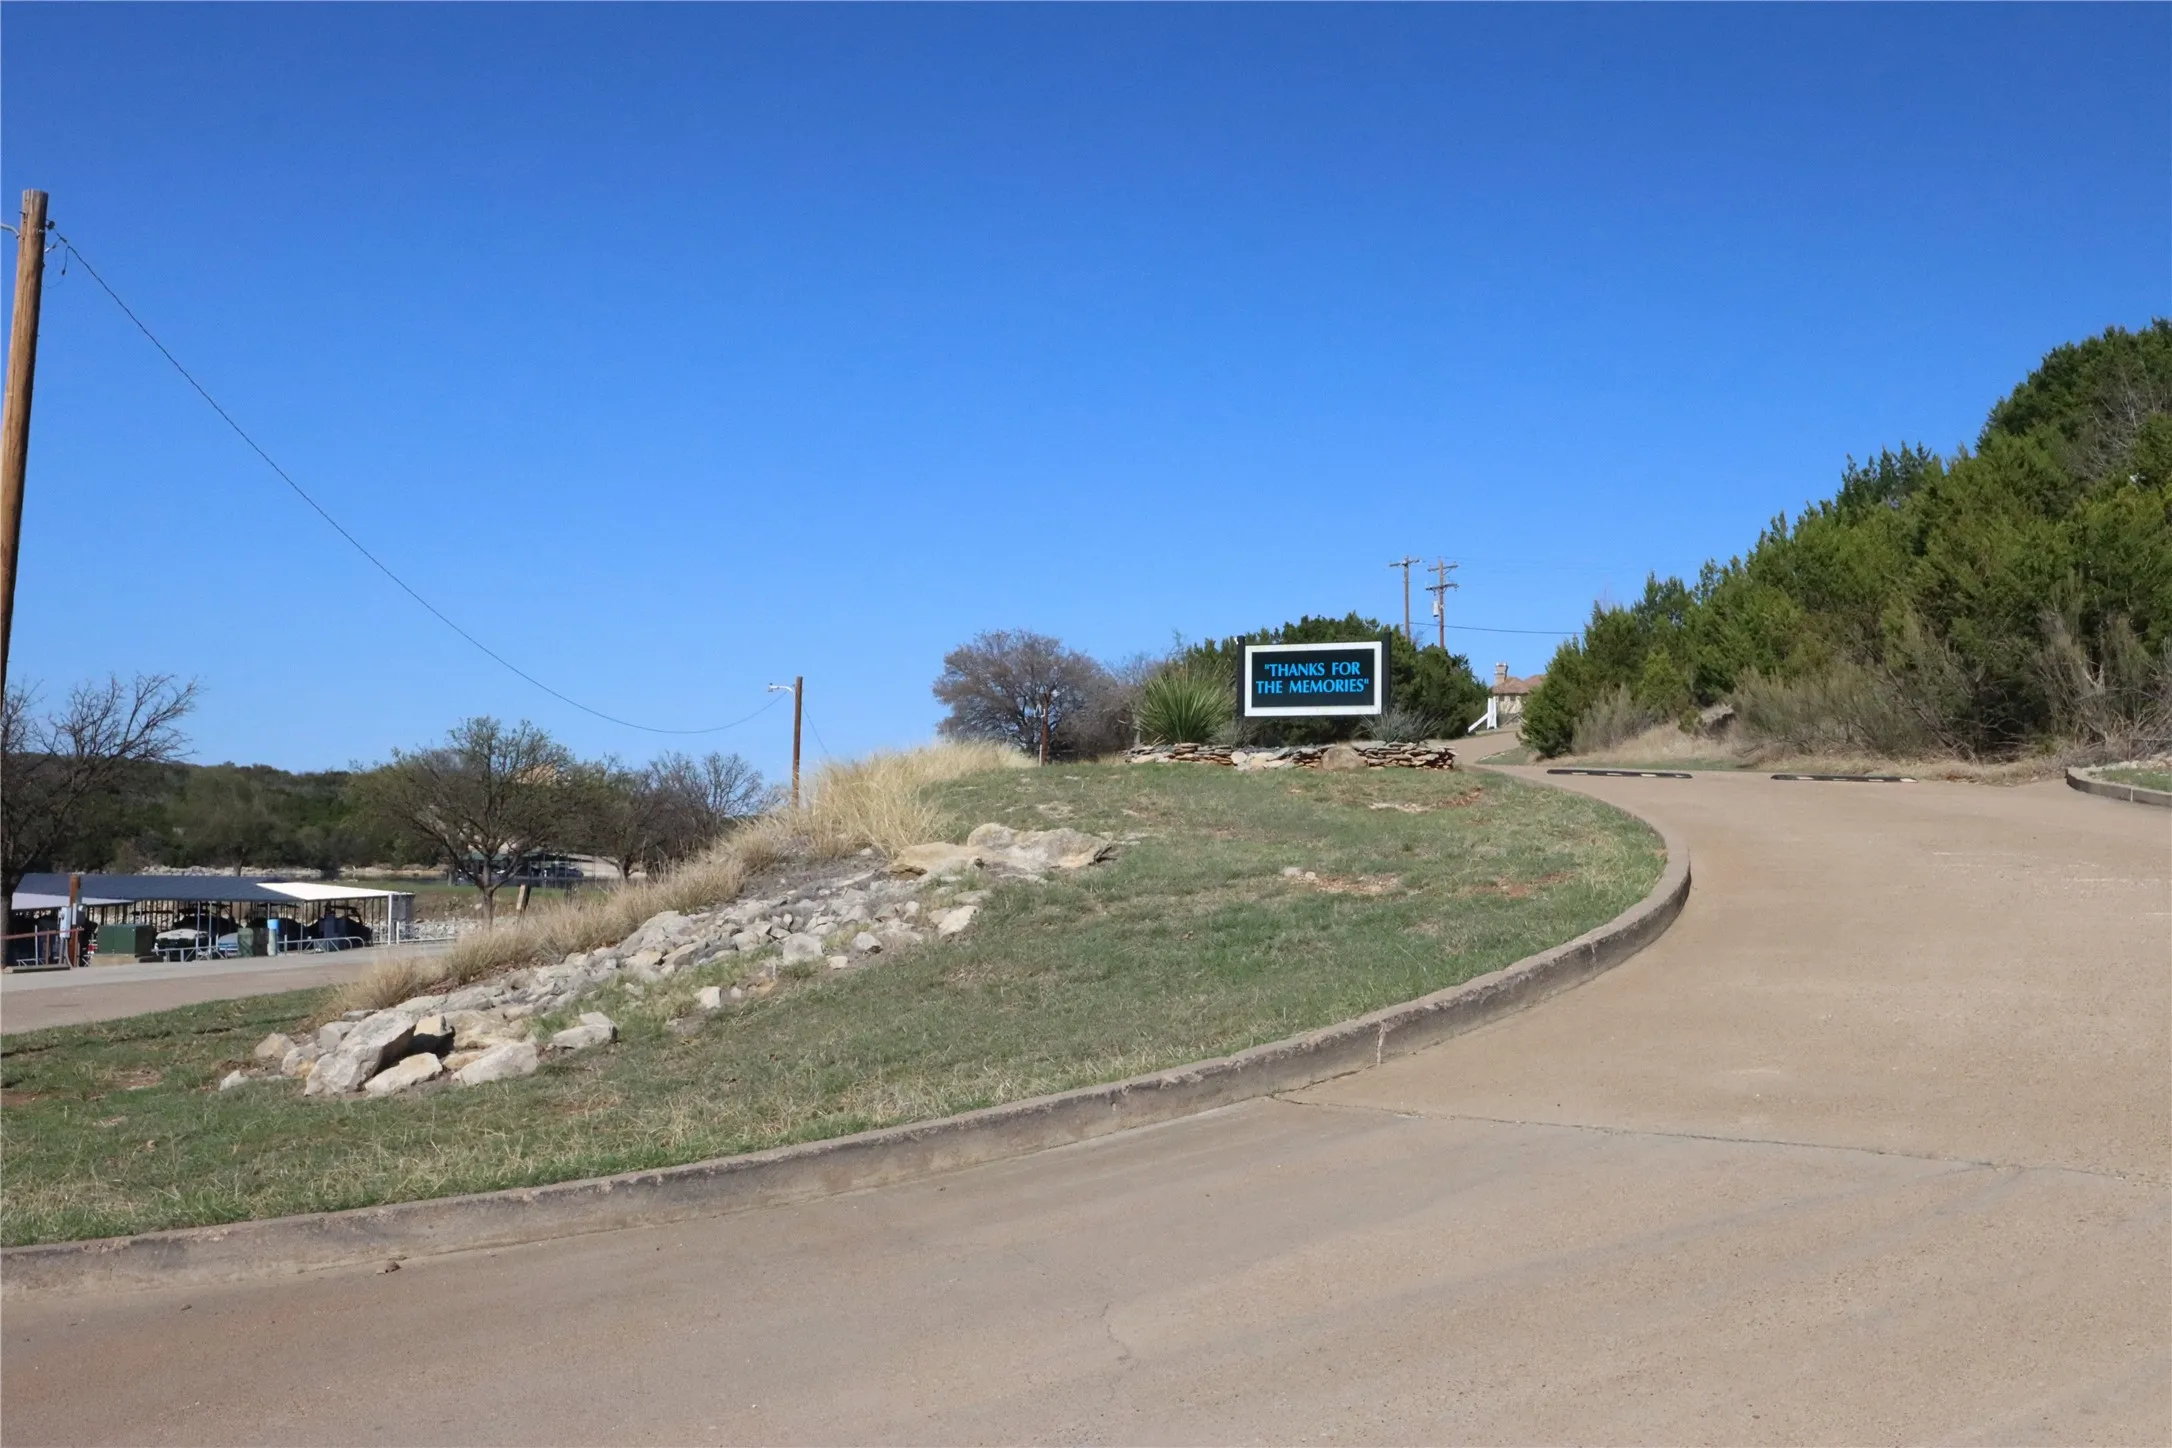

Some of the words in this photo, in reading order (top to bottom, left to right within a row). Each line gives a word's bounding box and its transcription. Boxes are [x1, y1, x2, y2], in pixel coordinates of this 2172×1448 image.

[1264, 662, 1325, 677] "THANKS
[1331, 661, 1361, 676] FOR
[1256, 680, 1283, 694] THE
[1289, 678, 1369, 693] MEMORIES"
